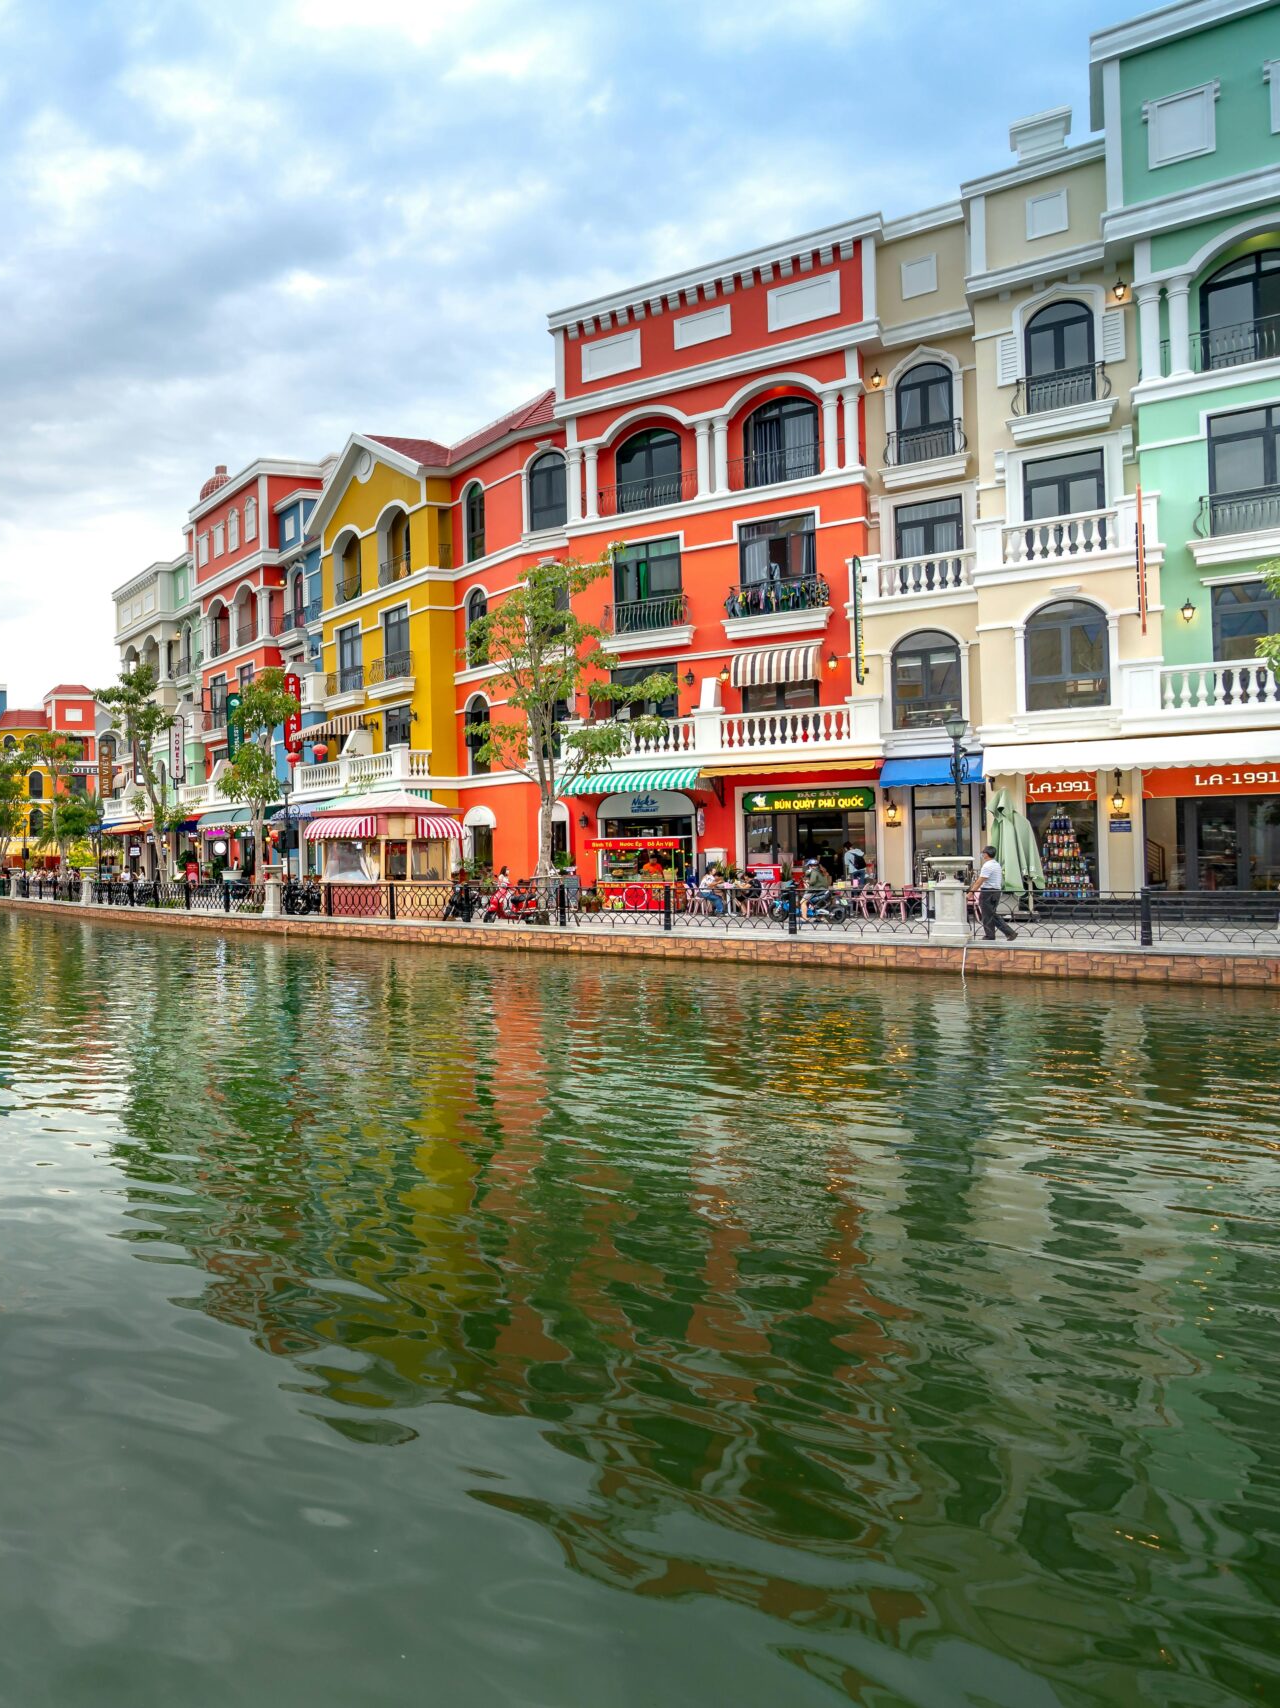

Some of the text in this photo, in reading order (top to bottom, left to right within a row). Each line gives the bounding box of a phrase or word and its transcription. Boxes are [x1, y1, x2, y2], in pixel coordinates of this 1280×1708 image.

[1194, 771, 1280, 786] LA-1991
[1028, 780, 1092, 794] LA-1991
[774, 798, 791, 809] BÚN
[793, 797, 816, 810] QUẬY
[818, 797, 835, 808] PHÚ
[837, 795, 864, 808] QUỐC
